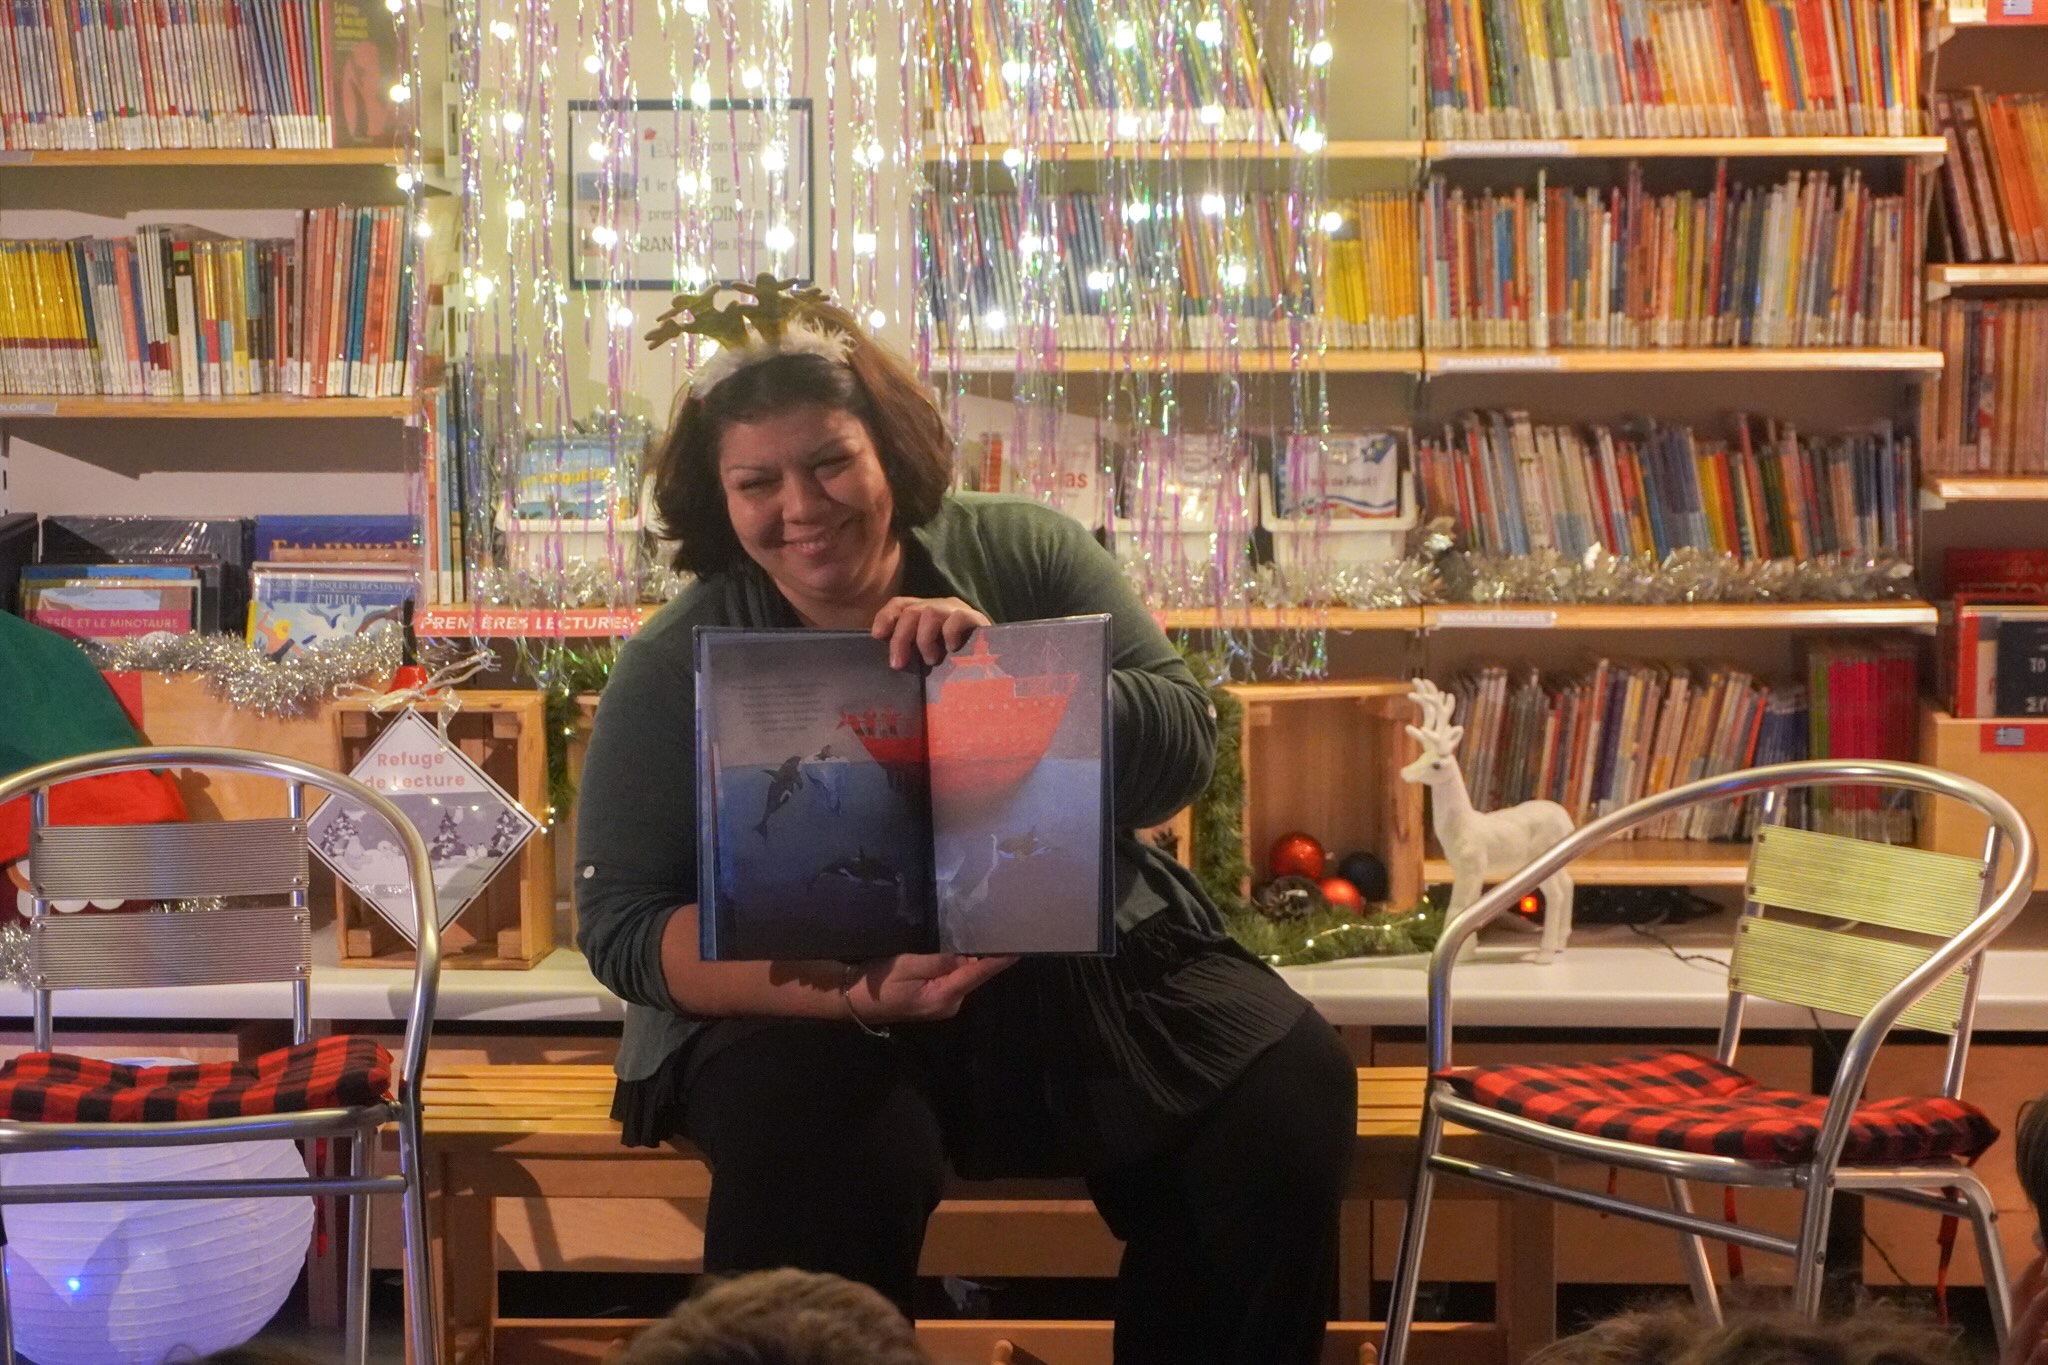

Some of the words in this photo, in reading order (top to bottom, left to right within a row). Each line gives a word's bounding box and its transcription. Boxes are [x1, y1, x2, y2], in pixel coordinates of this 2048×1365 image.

[78, 618, 89, 628] ET
[94, 618, 105, 628] LE
[110, 618, 178, 628] MINOTAURE
[420, 613, 529, 630] PREMÈRES
[377, 751, 444, 769] Refuge
[364, 776, 386, 789] de
